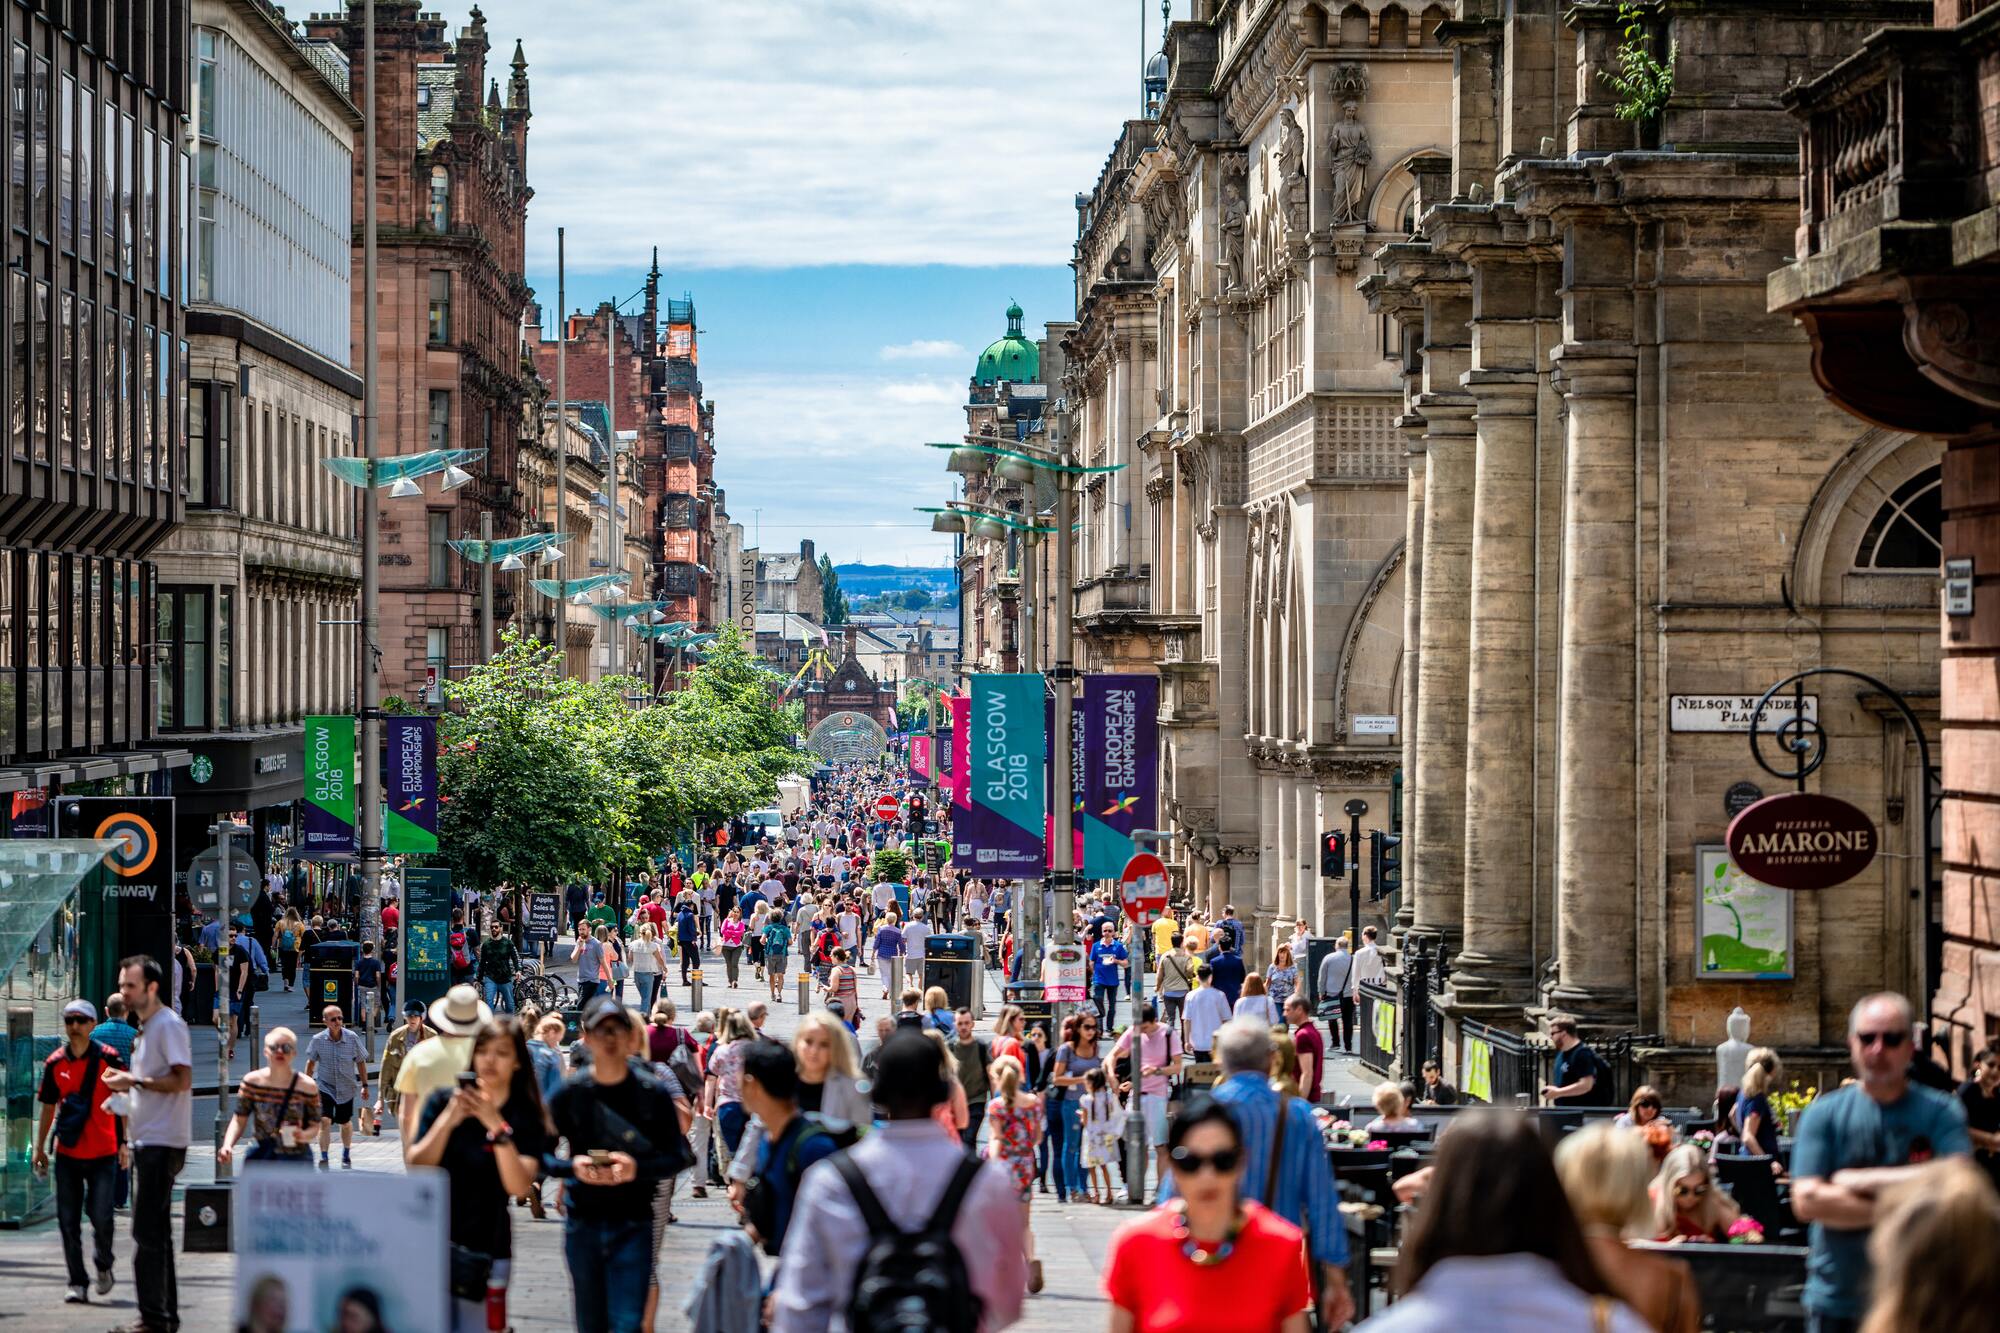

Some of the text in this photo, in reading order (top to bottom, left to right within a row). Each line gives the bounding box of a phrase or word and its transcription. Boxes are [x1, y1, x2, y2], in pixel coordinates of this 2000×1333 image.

[742, 559, 754, 575] ST
[1678, 698, 1733, 709] NELSON
[987, 691, 1006, 800] GLASGOW
[1105, 689, 1123, 788] EUROPEAN
[1123, 690, 1136, 788] CHAMPIONSHIPS
[315, 726, 329, 801] GLASGOW
[402, 726, 414, 792] EUROPEAN
[413, 726, 423, 792] CHAMPIONSHIPS
[1008, 754, 1028, 800] 2018
[330, 768, 344, 801] 2018
[1739, 830, 1869, 854] AMARONE
[1775, 820, 1831, 830] PIZZERIA
[533, 912, 555, 920] Repairs
[536, 896, 554, 904] Apple
